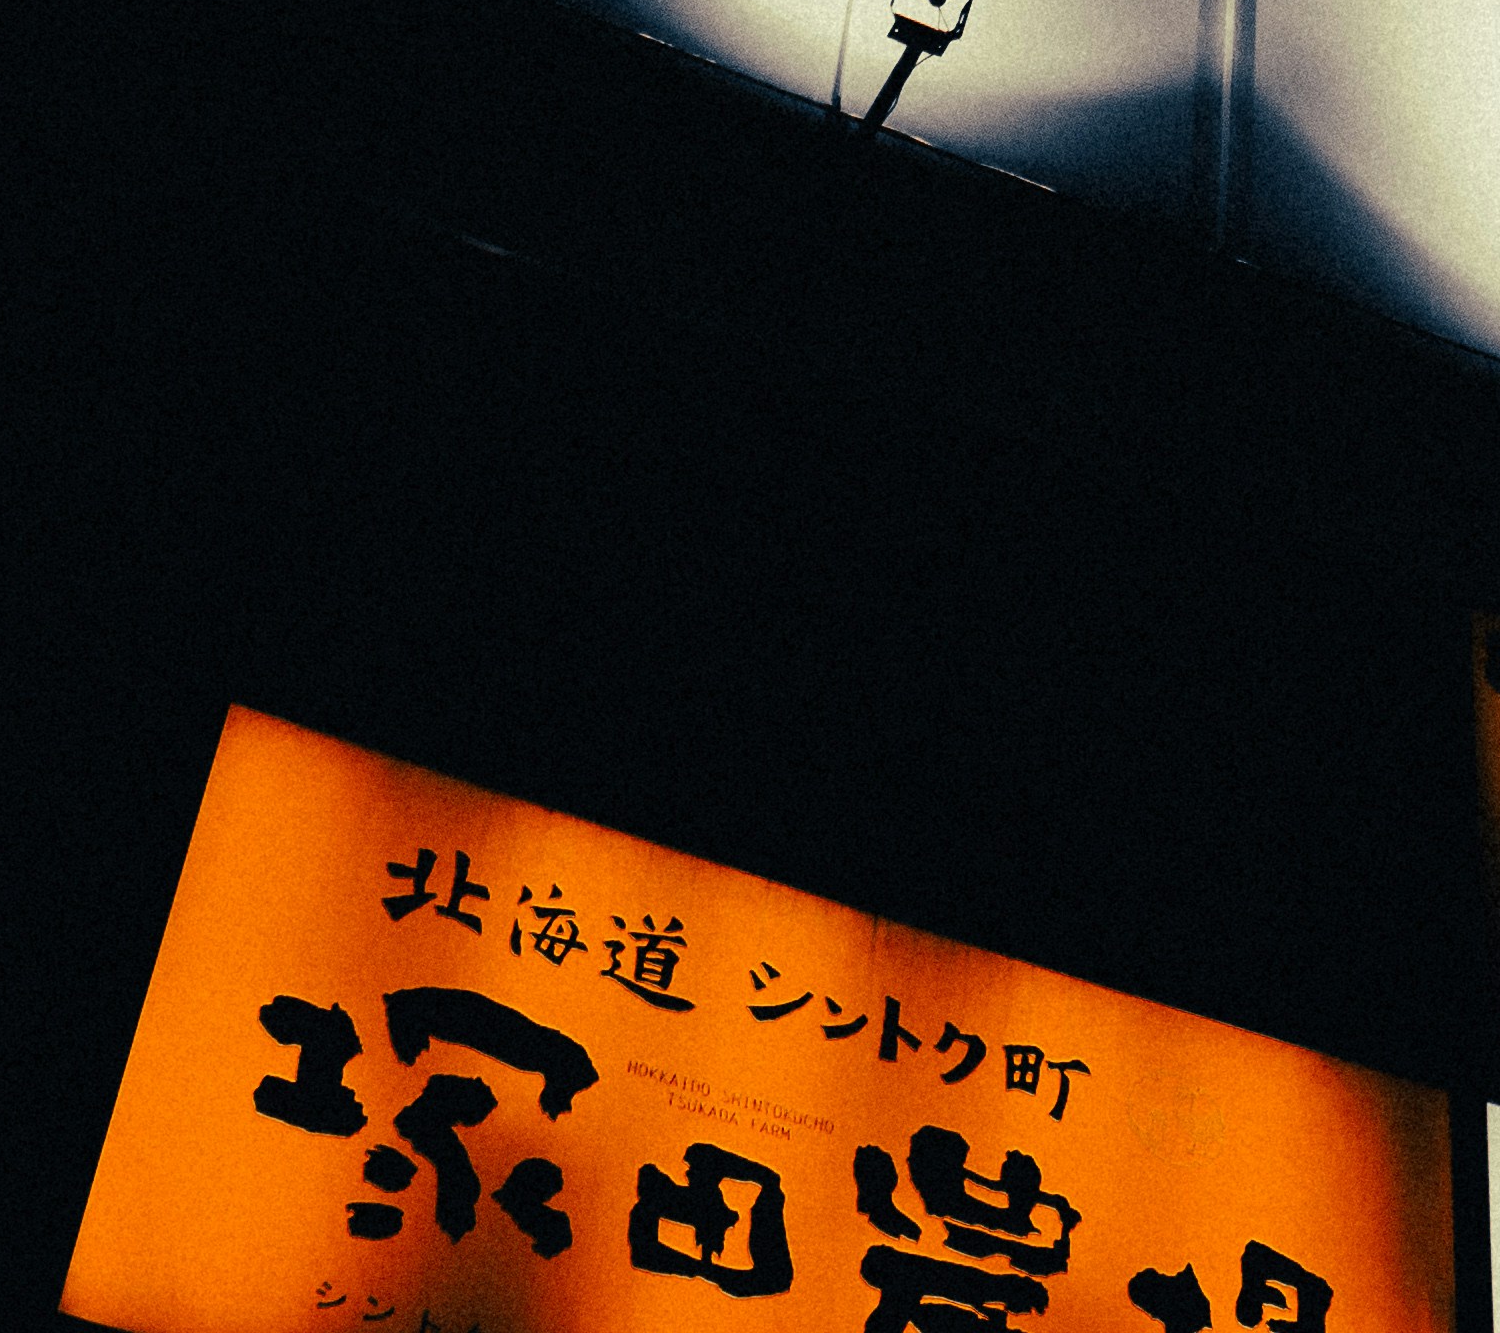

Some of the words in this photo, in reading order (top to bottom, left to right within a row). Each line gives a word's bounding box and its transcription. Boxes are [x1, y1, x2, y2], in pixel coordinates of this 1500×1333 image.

[381, 847, 696, 1013] 北海道
[746, 962, 1092, 1122] シントク町
[627, 1059, 712, 1097] HOKKAIDO
[667, 1091, 739, 1126] TSUKADA
[750, 1118, 792, 1141] FARM
